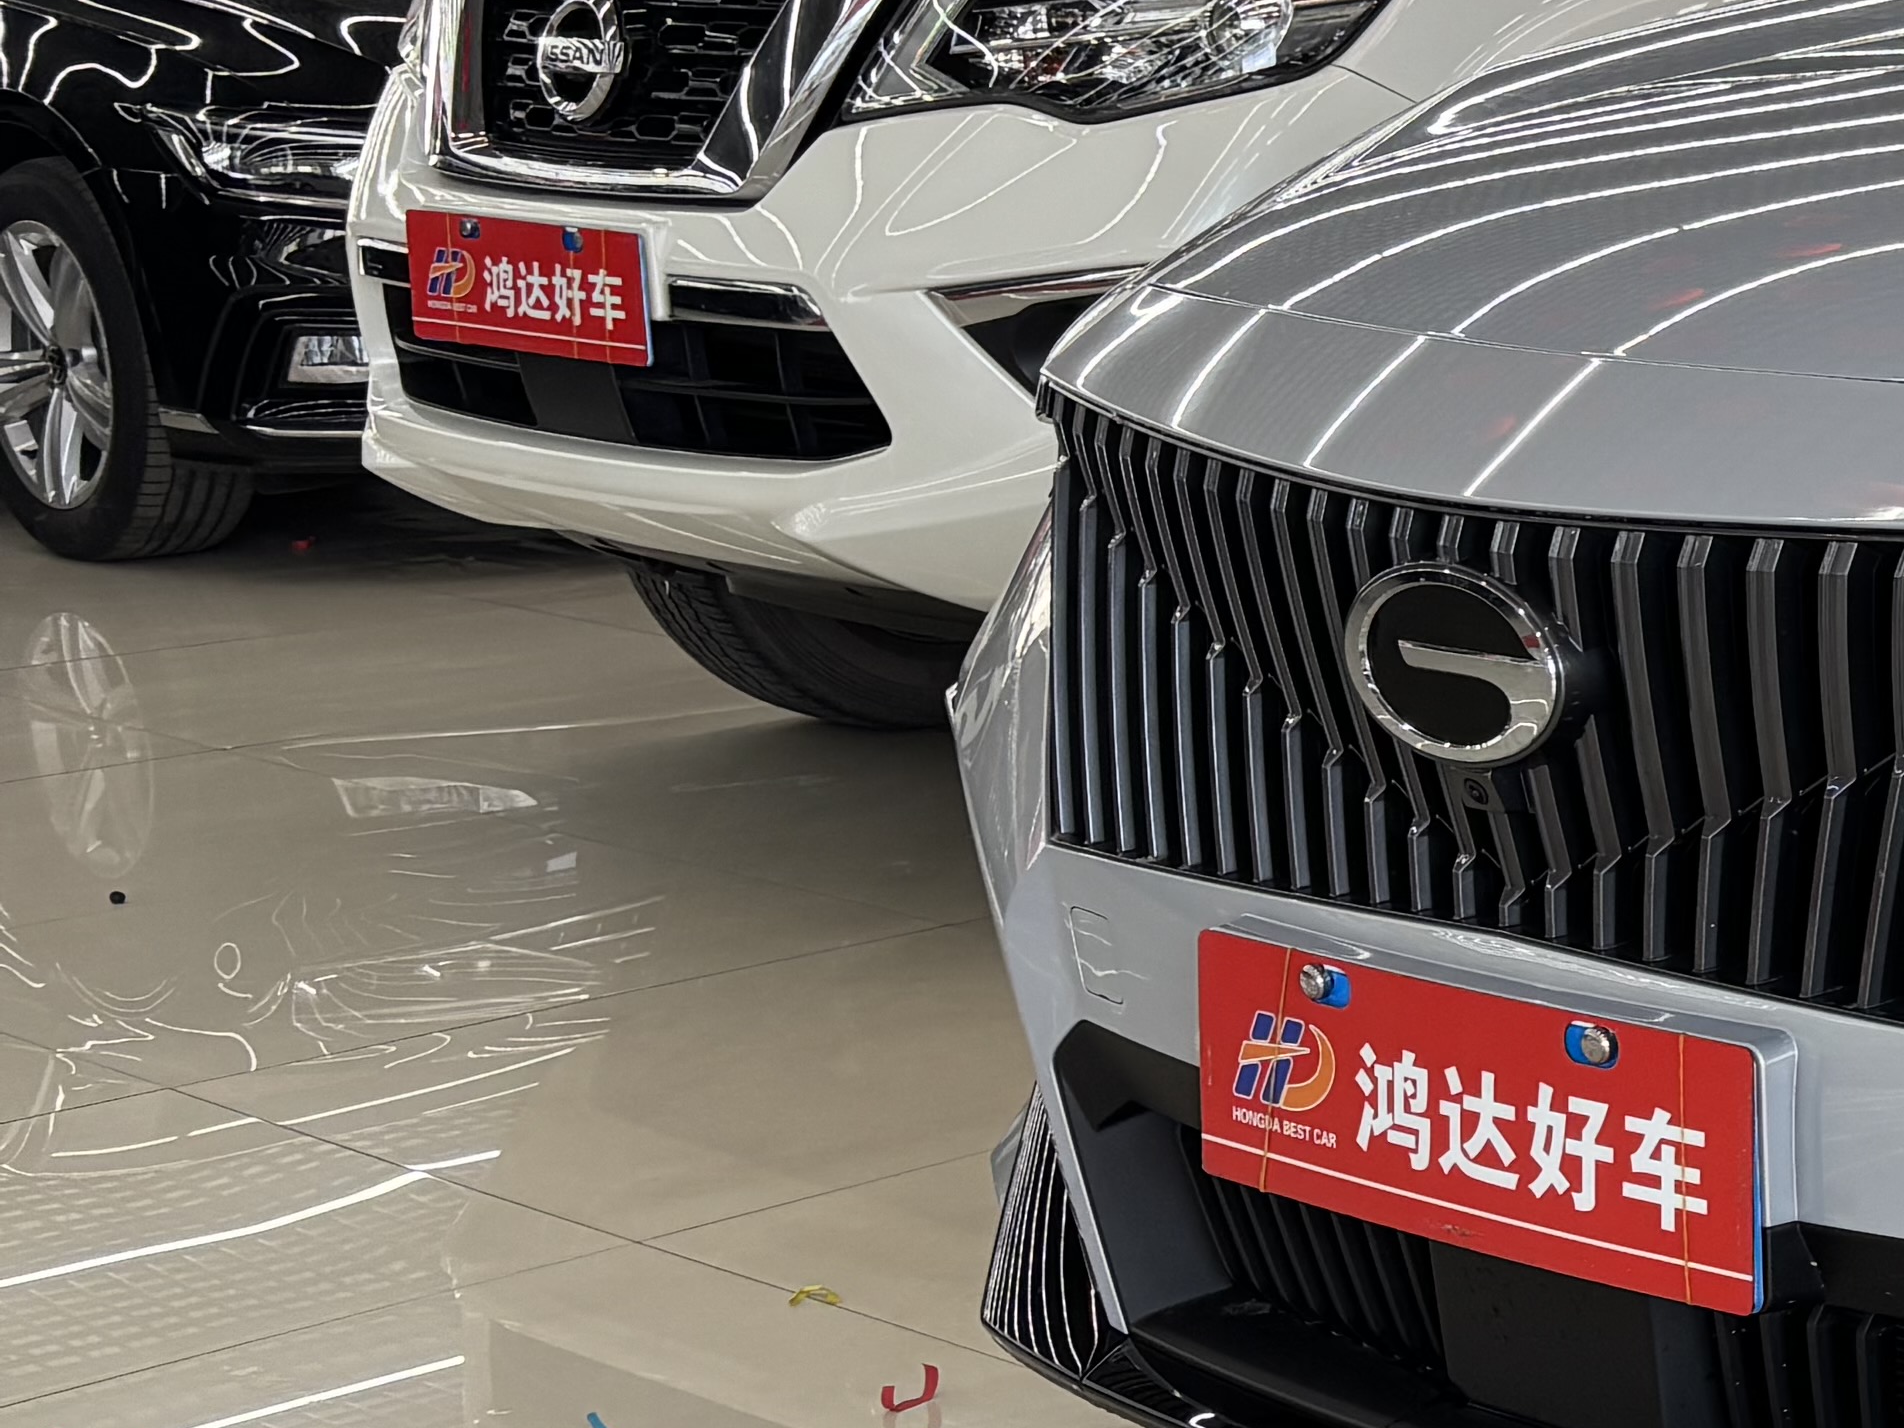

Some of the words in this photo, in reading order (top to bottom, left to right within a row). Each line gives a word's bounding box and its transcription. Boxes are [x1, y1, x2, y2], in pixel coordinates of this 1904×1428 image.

[546, 43, 605, 66] SSAN
[483, 255, 627, 331] 鸿达好车
[1232, 1105, 1281, 1133] HONGDA
[1282, 1119, 1311, 1142] BEST
[1313, 1128, 1337, 1149] CAR
[1355, 1042, 1709, 1233] 鸿达好车
